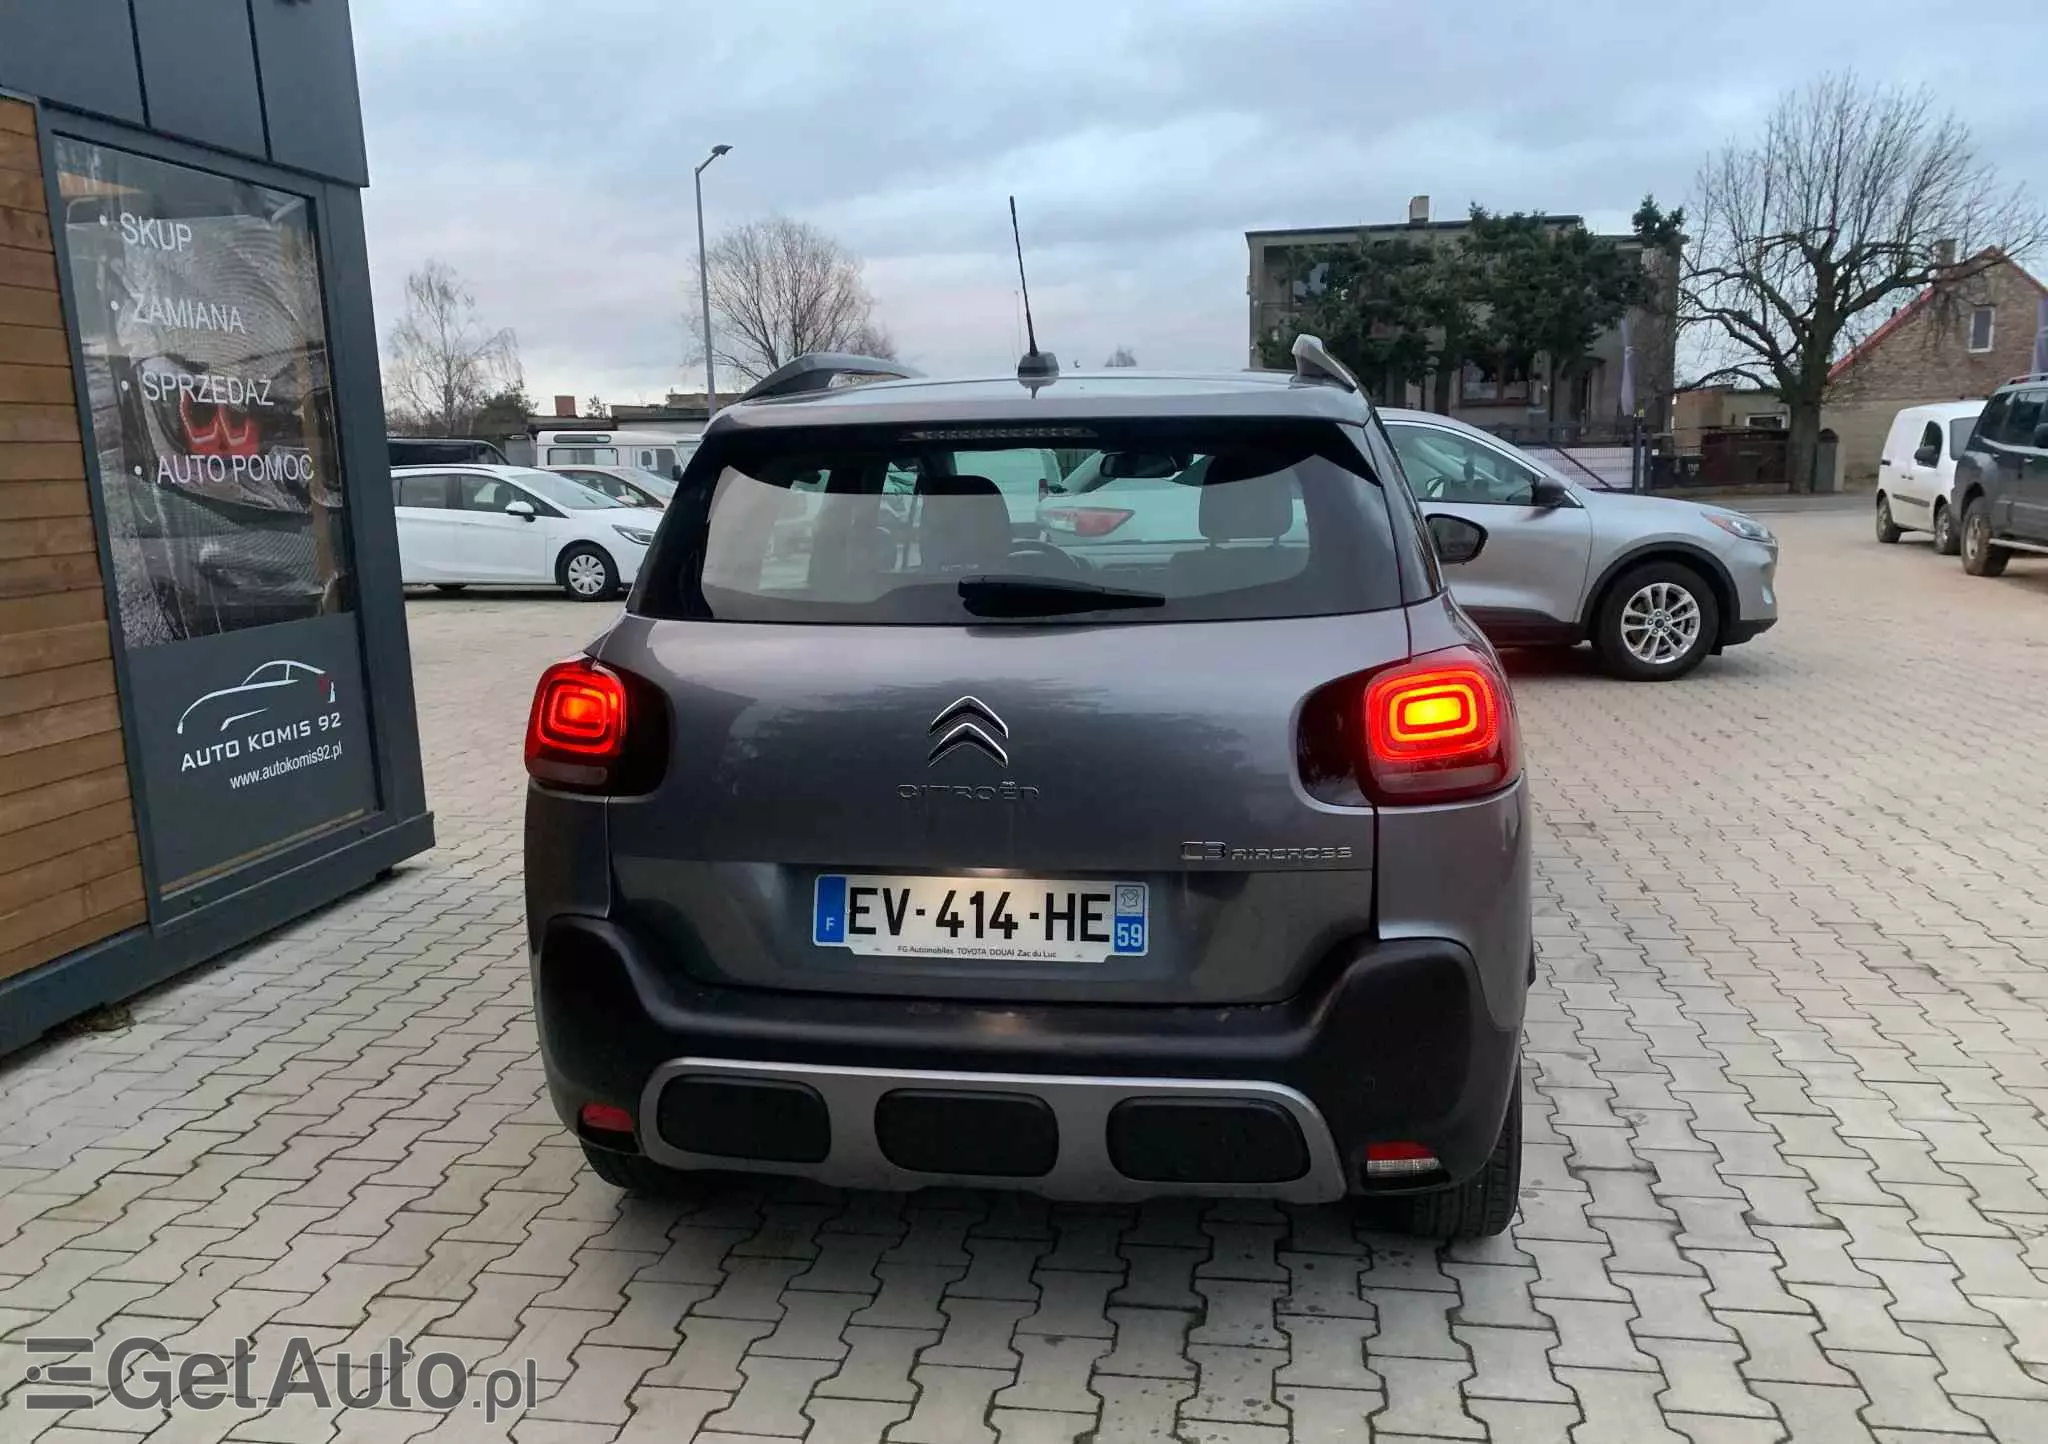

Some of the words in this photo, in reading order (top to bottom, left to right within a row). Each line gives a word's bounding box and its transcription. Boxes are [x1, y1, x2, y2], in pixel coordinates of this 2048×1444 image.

[119, 211, 193, 252] SKUP
[131, 292, 247, 335] ZAMIANA
[156, 455, 226, 485] AUTO
[231, 454, 315, 482] POMOC
[181, 739, 240, 773] AUTO
[248, 720, 312, 753] KOMIS
[317, 712, 342, 732] 92
[229, 740, 343, 790] www.autokomis92.pl
[1180, 841, 1227, 861] C3
[1231, 846, 1353, 861] AIRCROSS
[825, 916, 836, 931] F
[848, 886, 1111, 943] EV-414-HE
[957, 947, 987, 957] TOYOTA
[989, 948, 1015, 957] DOUAI
[1016, 949, 1032, 958] Zac
[1032, 949, 1042, 958] du
[1117, 922, 1143, 948] 59
